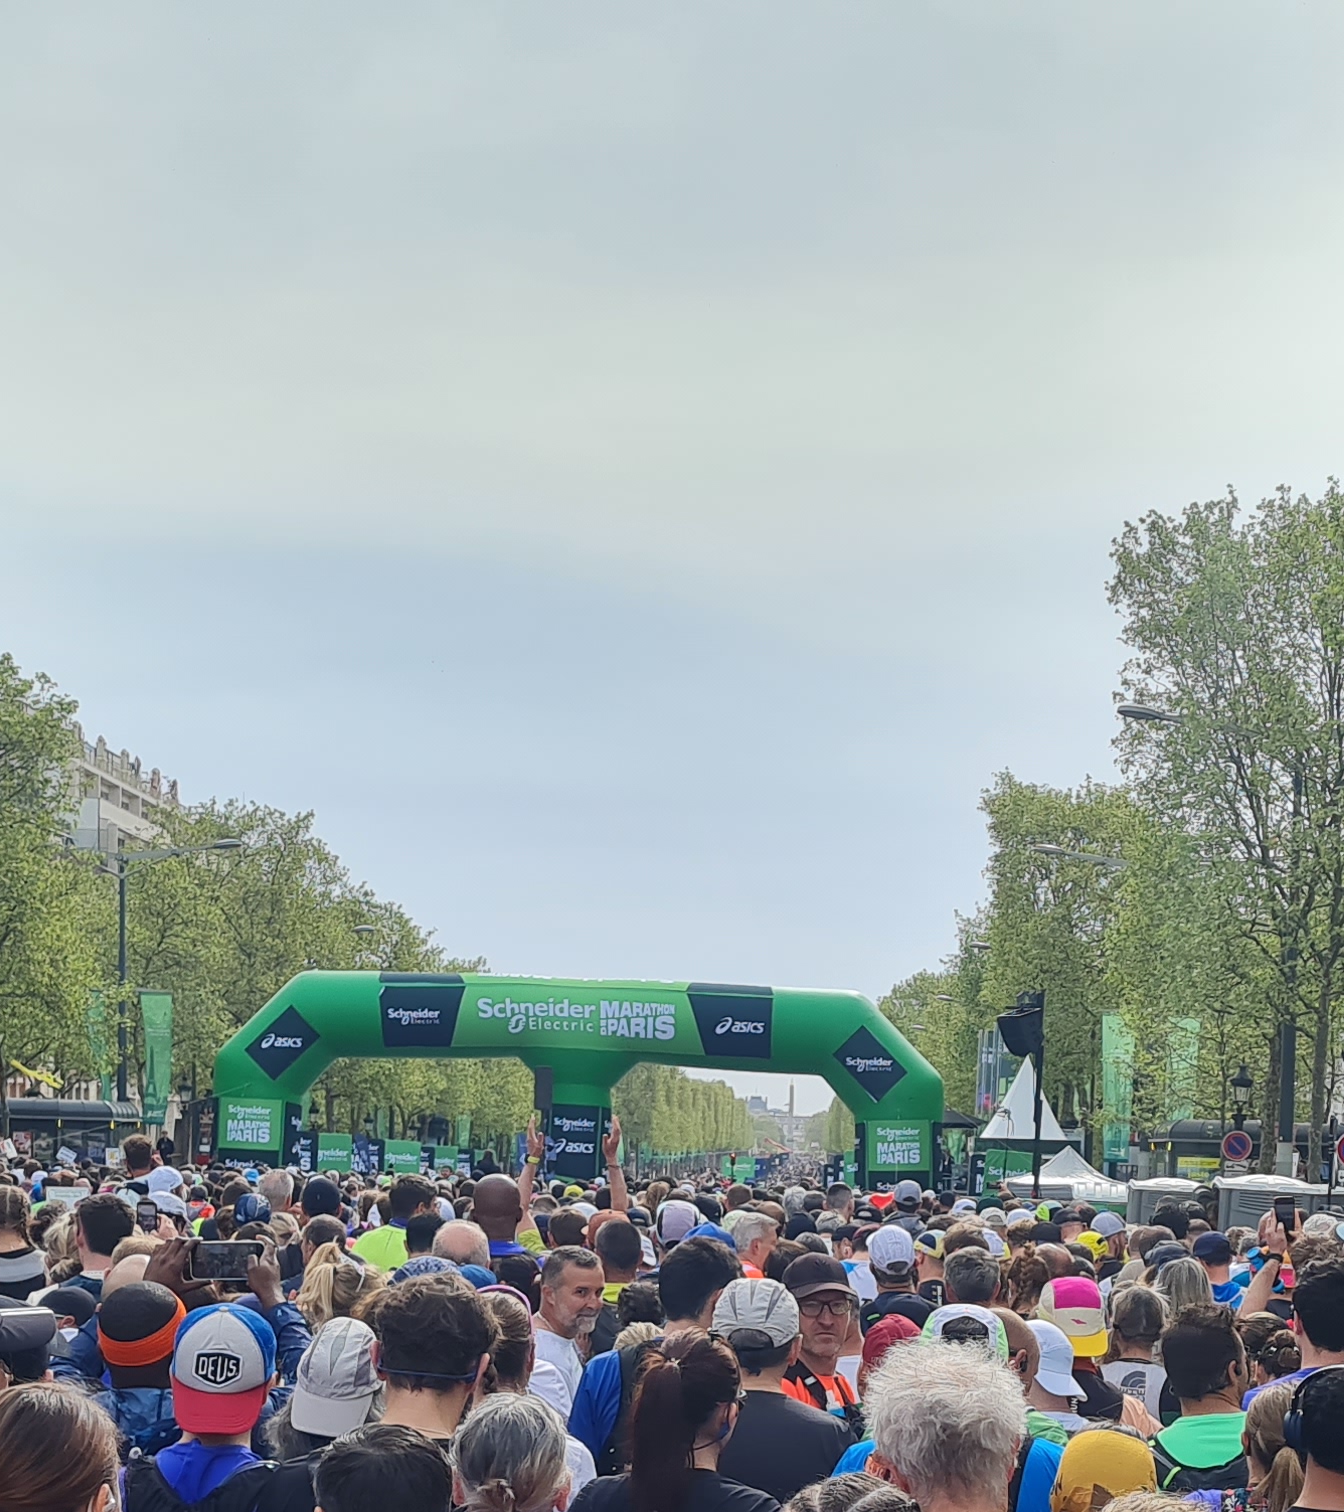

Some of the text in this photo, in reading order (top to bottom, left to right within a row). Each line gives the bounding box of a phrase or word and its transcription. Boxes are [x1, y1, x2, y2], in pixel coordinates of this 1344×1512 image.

[387, 1008, 441, 1021] Schneider
[600, 1000, 675, 1019] MARATHON
[477, 997, 596, 1019] Schneider
[607, 1015, 676, 1041] PARIS
[528, 1018, 595, 1033] Electric
[731, 1020, 766, 1034] asics
[273, 1036, 303, 1048] asics
[845, 1056, 893, 1069] Schneider
[228, 1104, 271, 1117] Schneider
[565, 1142, 595, 1153] asics
[198, 1356, 237, 1382] DEUS
